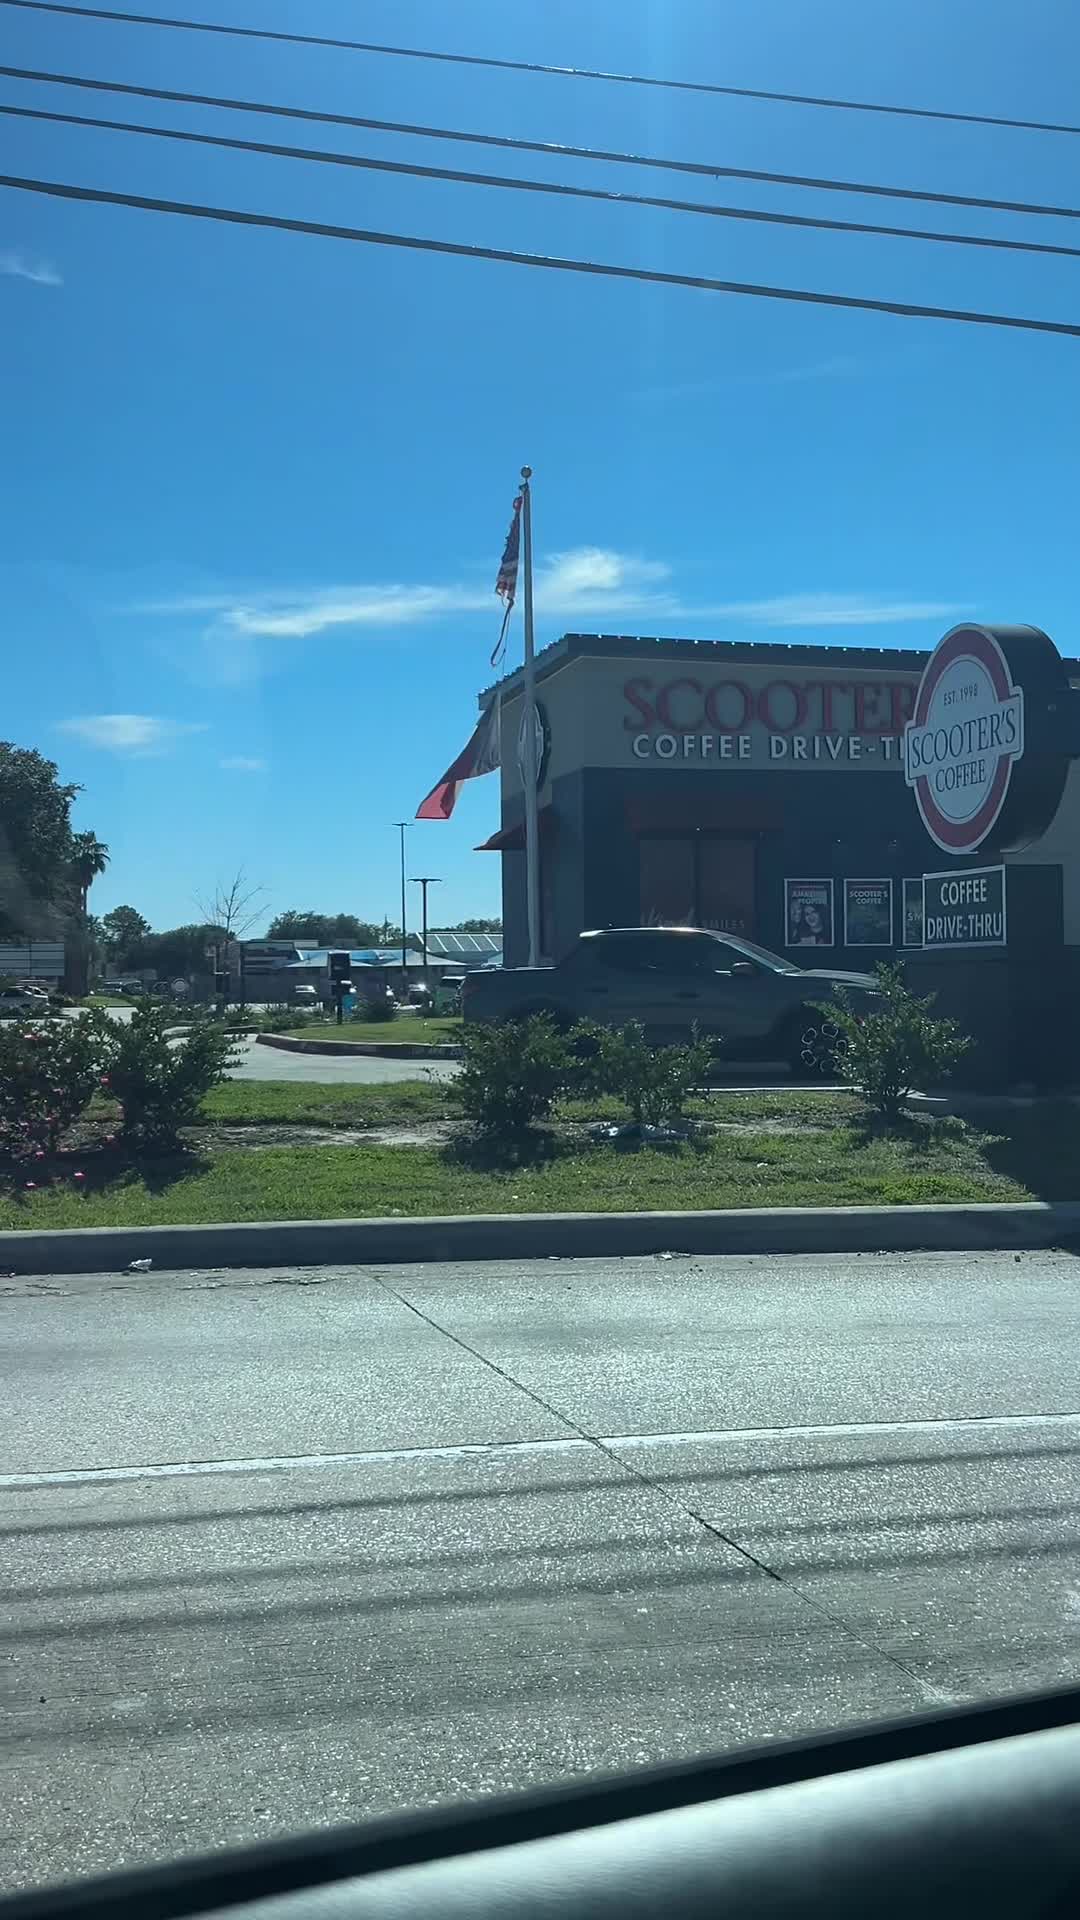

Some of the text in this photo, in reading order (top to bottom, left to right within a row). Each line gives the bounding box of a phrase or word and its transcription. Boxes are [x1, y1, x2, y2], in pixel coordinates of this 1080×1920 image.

[632, 734, 752, 760] COFFEE
[912, 708, 1016, 769] SCOOTER'S
[935, 759, 986, 793] COFFEE
[940, 878, 988, 906] COFFEE
[927, 912, 1002, 940] DRIVE-THRU
